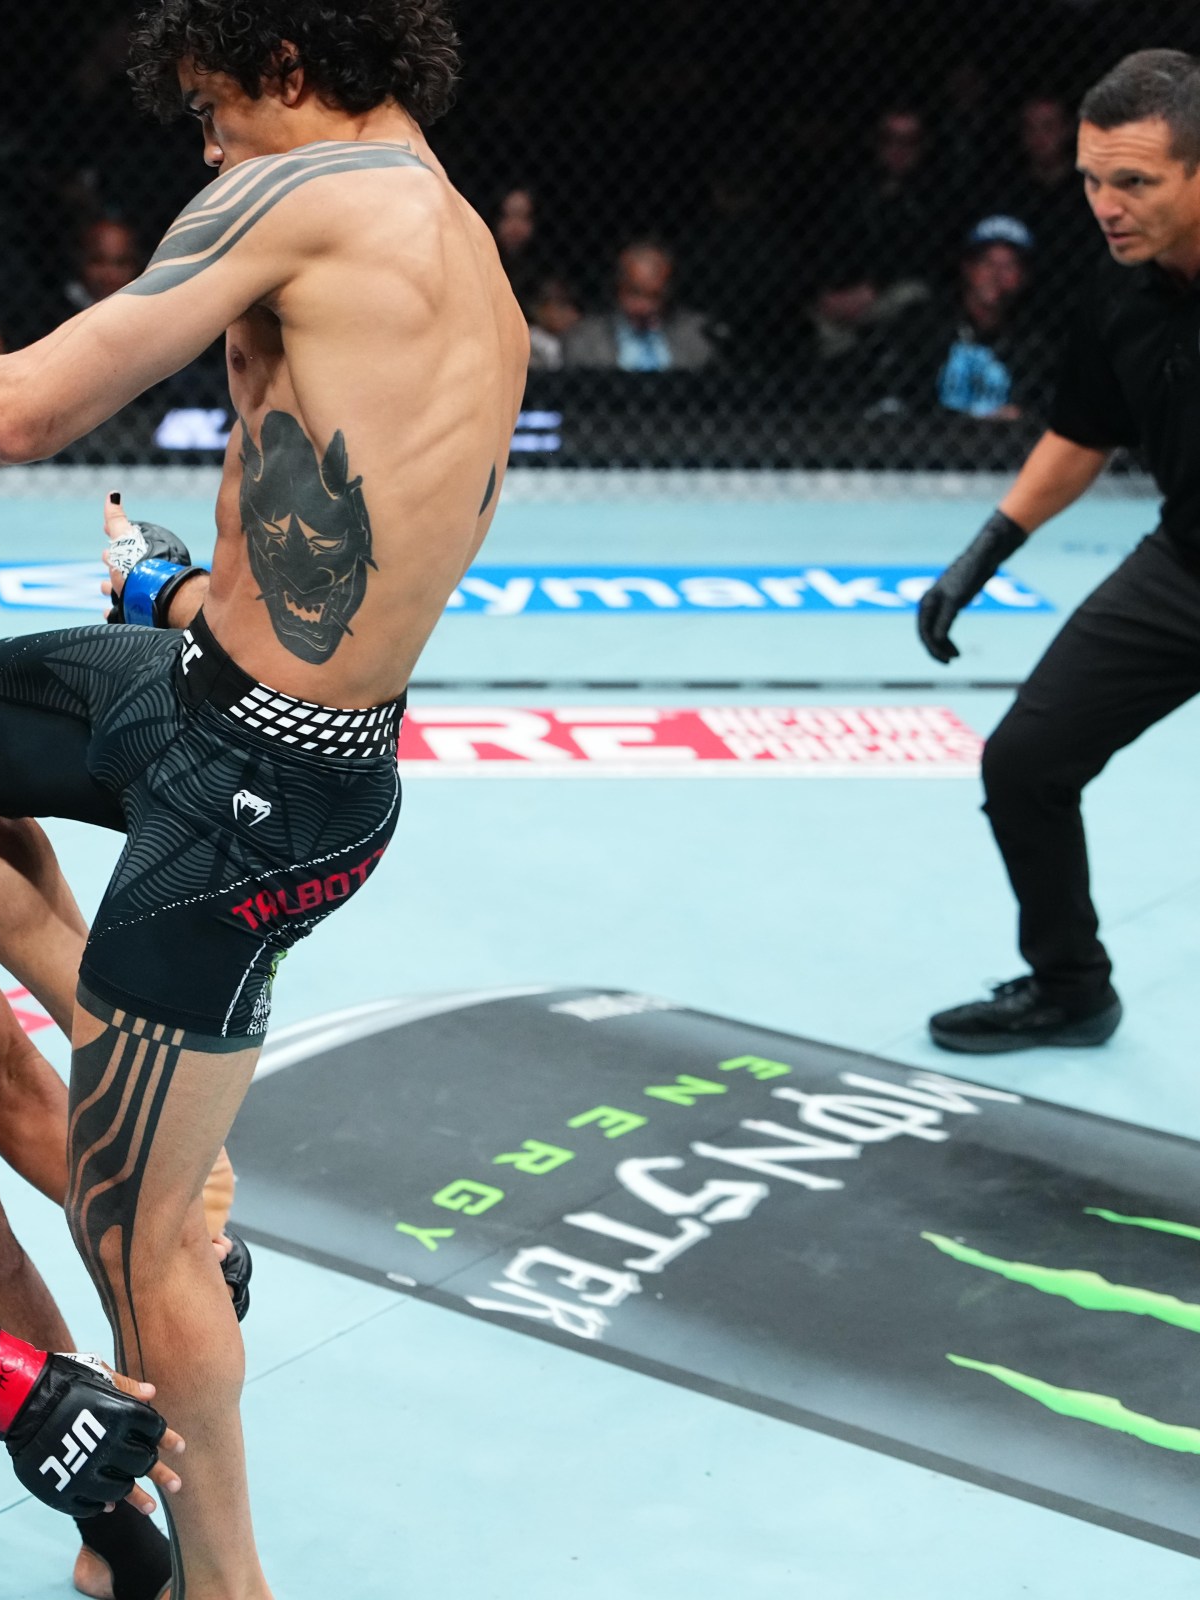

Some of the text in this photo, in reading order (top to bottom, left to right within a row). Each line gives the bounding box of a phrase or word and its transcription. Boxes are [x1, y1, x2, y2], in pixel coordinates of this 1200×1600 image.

[394, 1054, 792, 1251] ENERGY
[466, 1072, 1023, 1340] MONSTER
[38, 1408, 107, 1493] UFC
